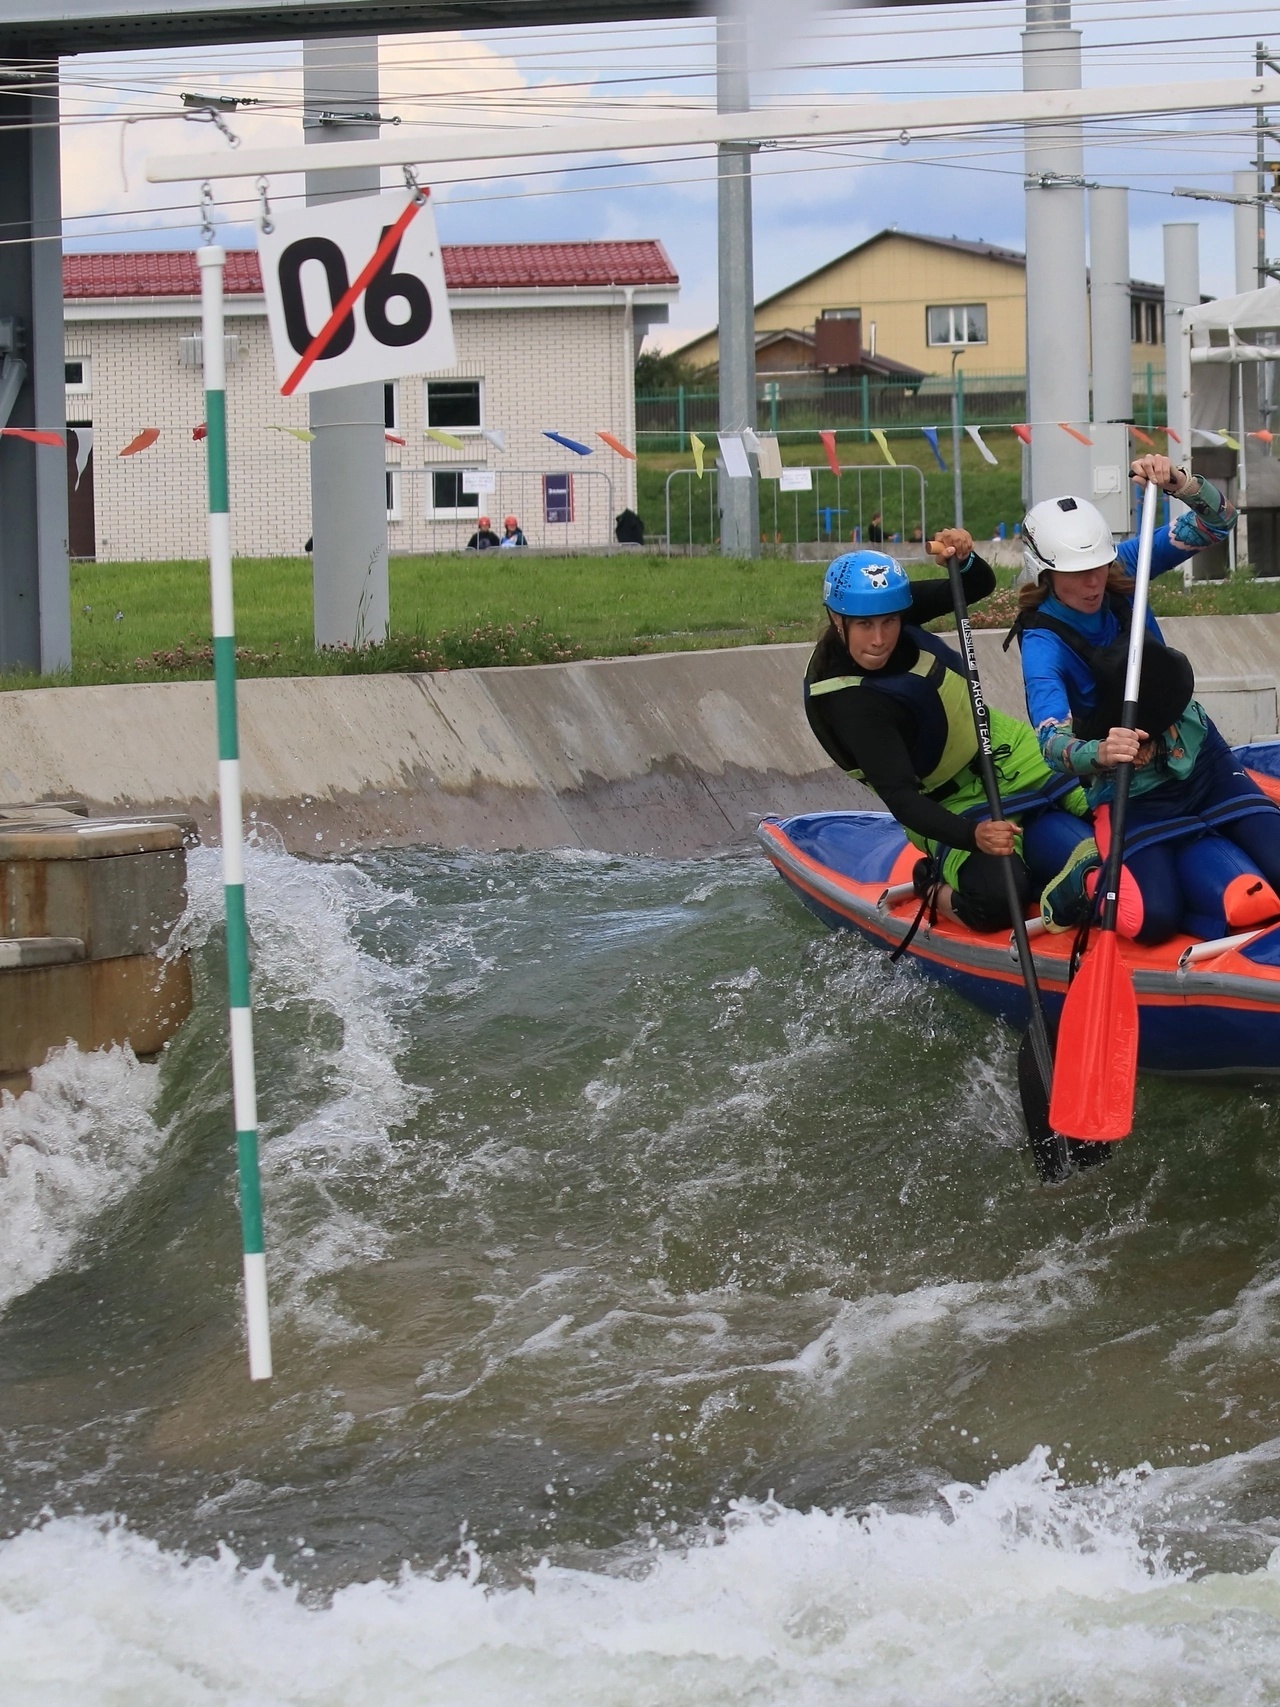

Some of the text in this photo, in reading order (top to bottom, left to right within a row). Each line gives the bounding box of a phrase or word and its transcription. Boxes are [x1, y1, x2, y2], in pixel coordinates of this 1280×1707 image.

[278, 223, 433, 361] 06
[962, 618, 993, 756] MISSILE ARGO TEAM
